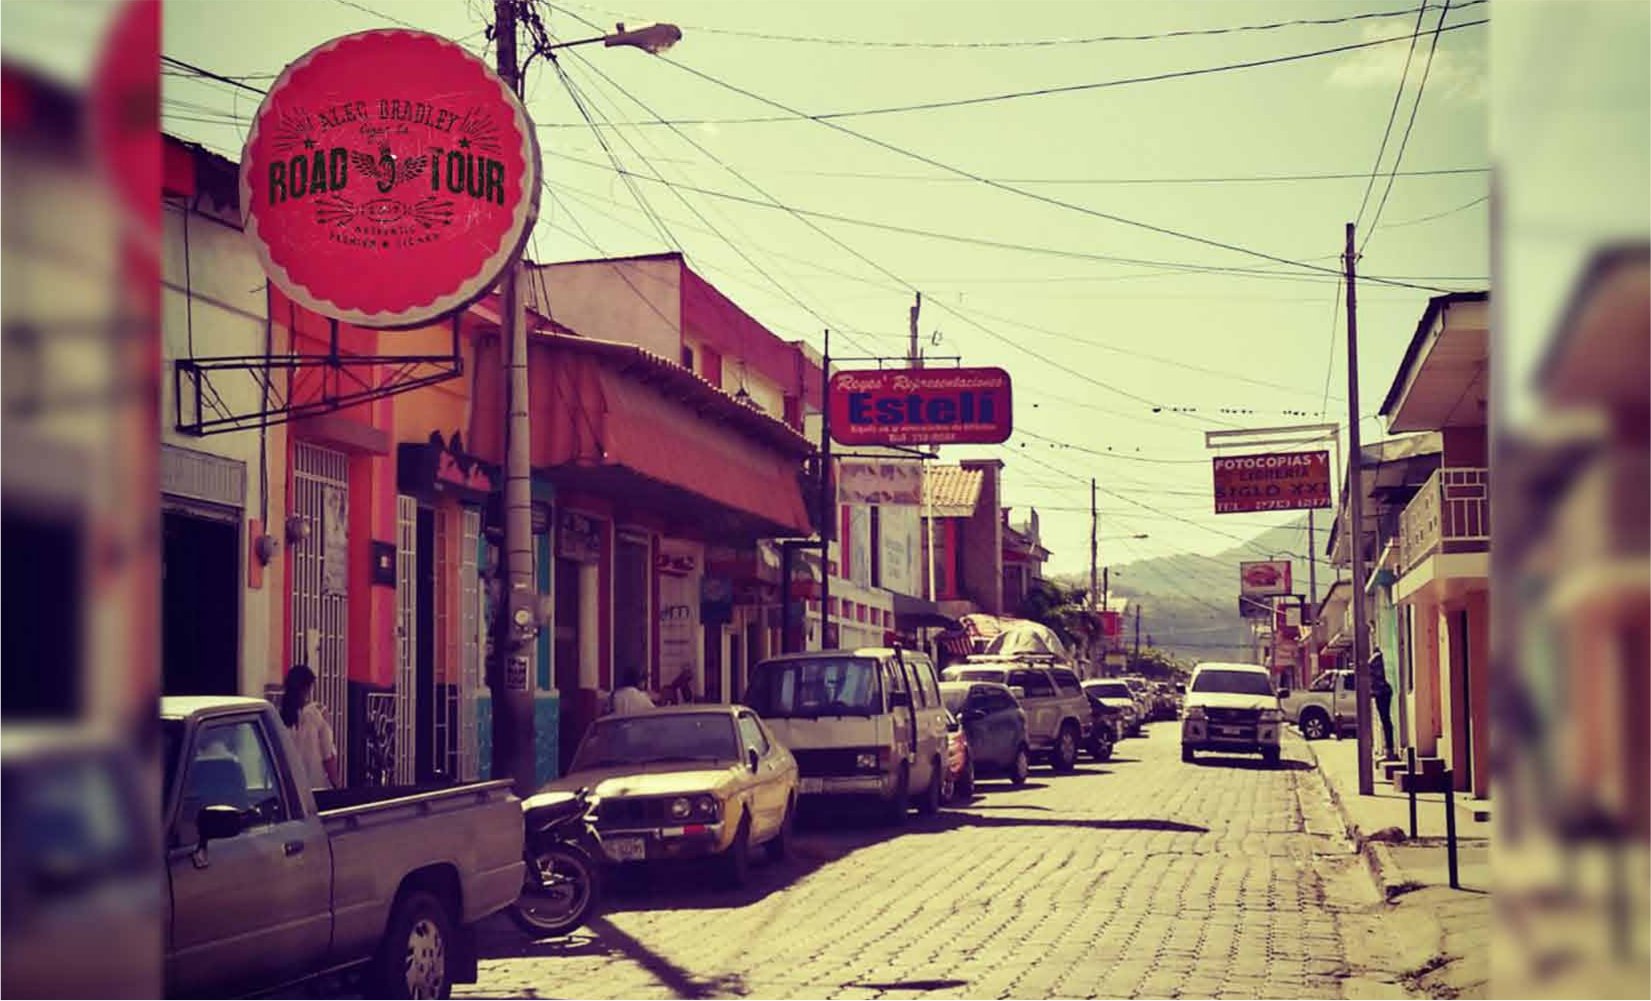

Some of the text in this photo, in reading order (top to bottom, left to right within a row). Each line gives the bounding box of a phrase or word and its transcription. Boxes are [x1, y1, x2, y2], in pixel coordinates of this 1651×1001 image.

[318, 98, 460, 133] ALEC BRADLEY
[268, 146, 506, 208] ROAD TOUR
[1215, 454, 1327, 470] FOTOCOPIAS Y
[1216, 485, 1280, 500] SIGLO
